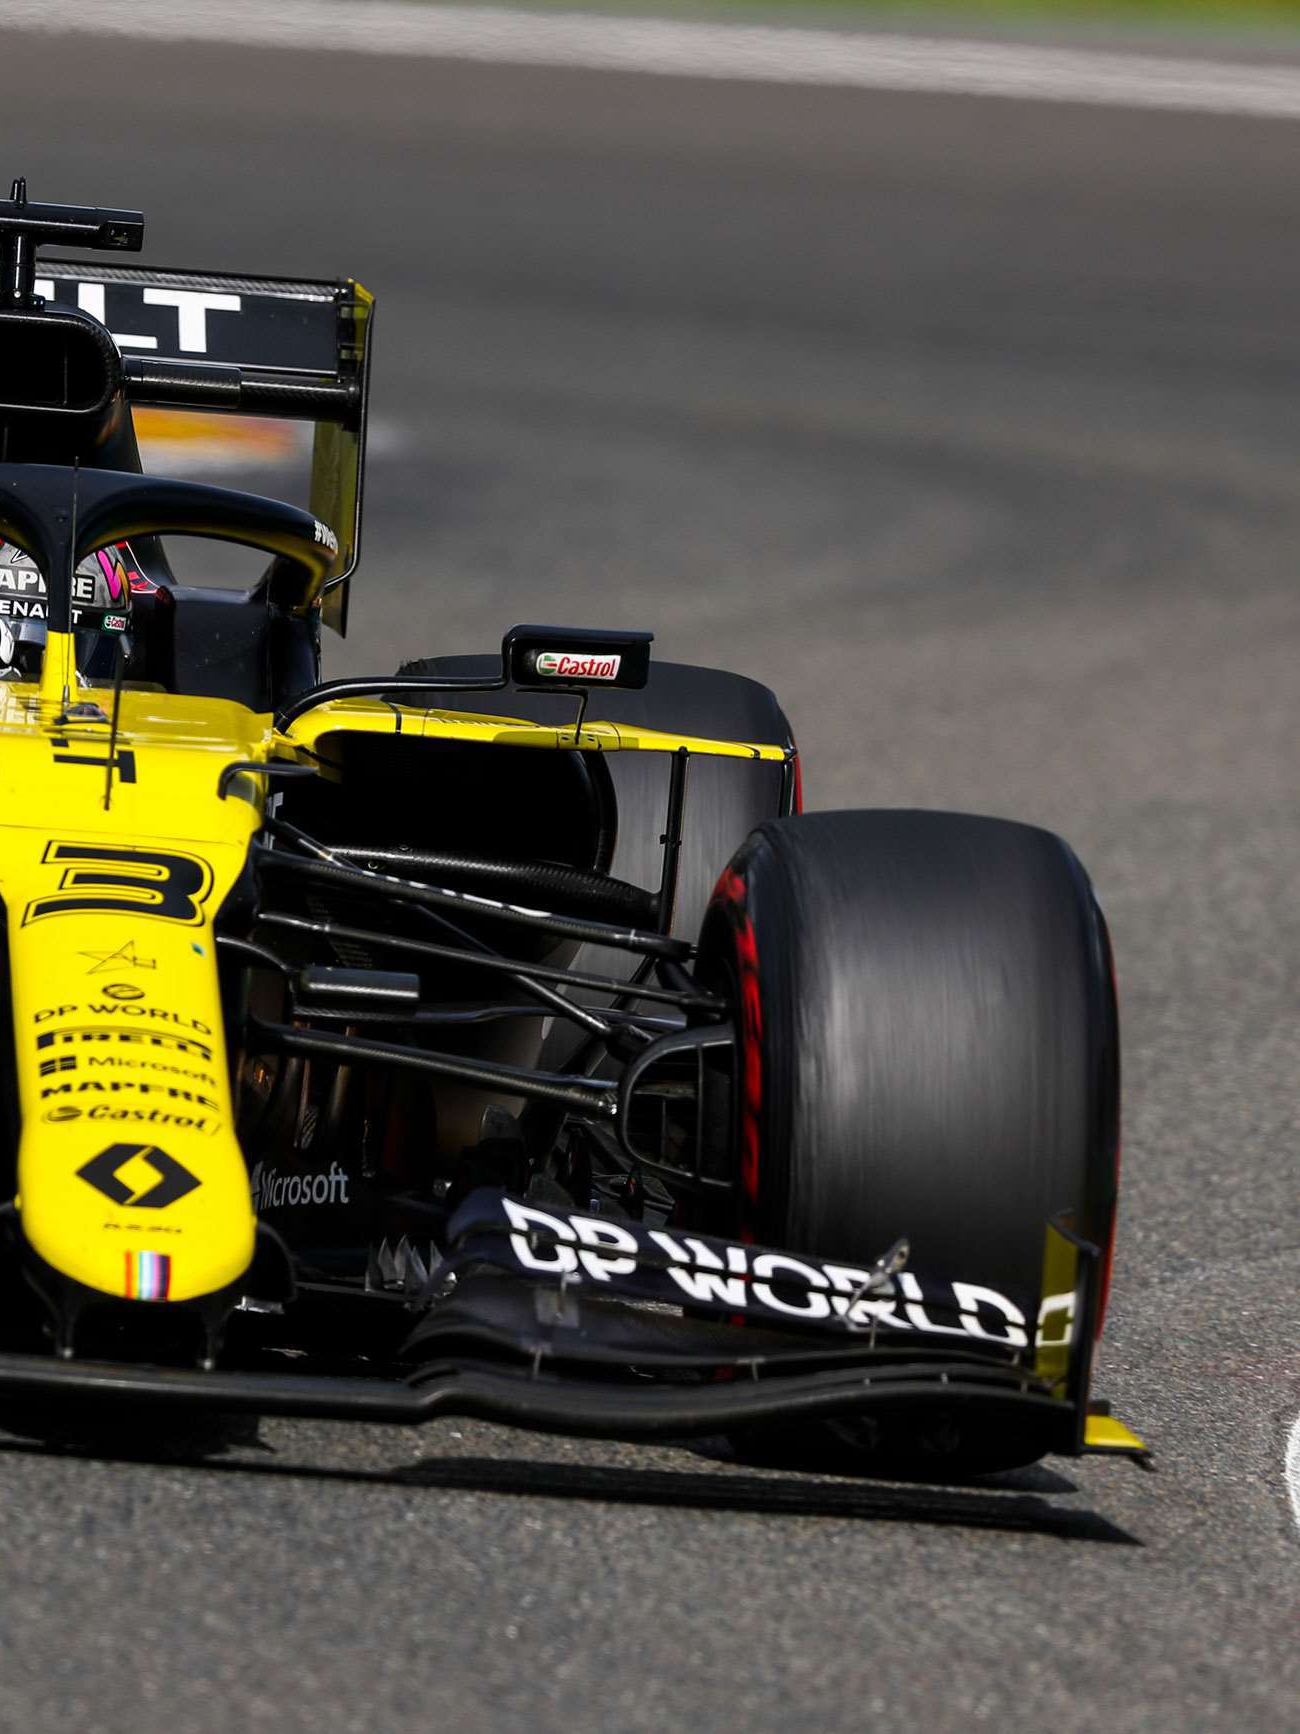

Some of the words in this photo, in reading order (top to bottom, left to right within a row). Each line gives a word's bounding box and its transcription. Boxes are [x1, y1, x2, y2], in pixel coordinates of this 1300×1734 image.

[556, 656, 616, 677] Castrol
[20, 839, 214, 929] 3
[34, 1004, 78, 1024] DP
[88, 1003, 212, 1035] WORLD
[36, 1025, 213, 1063] PIRELLI
[88, 1056, 217, 1089] Microsoft
[40, 1081, 221, 1113] MAPFRE
[88, 1104, 207, 1131] Castrol
[260, 1160, 349, 1210] Microsoft
[502, 1198, 638, 1282] DP
[649, 1229, 1028, 1347] WORLD
